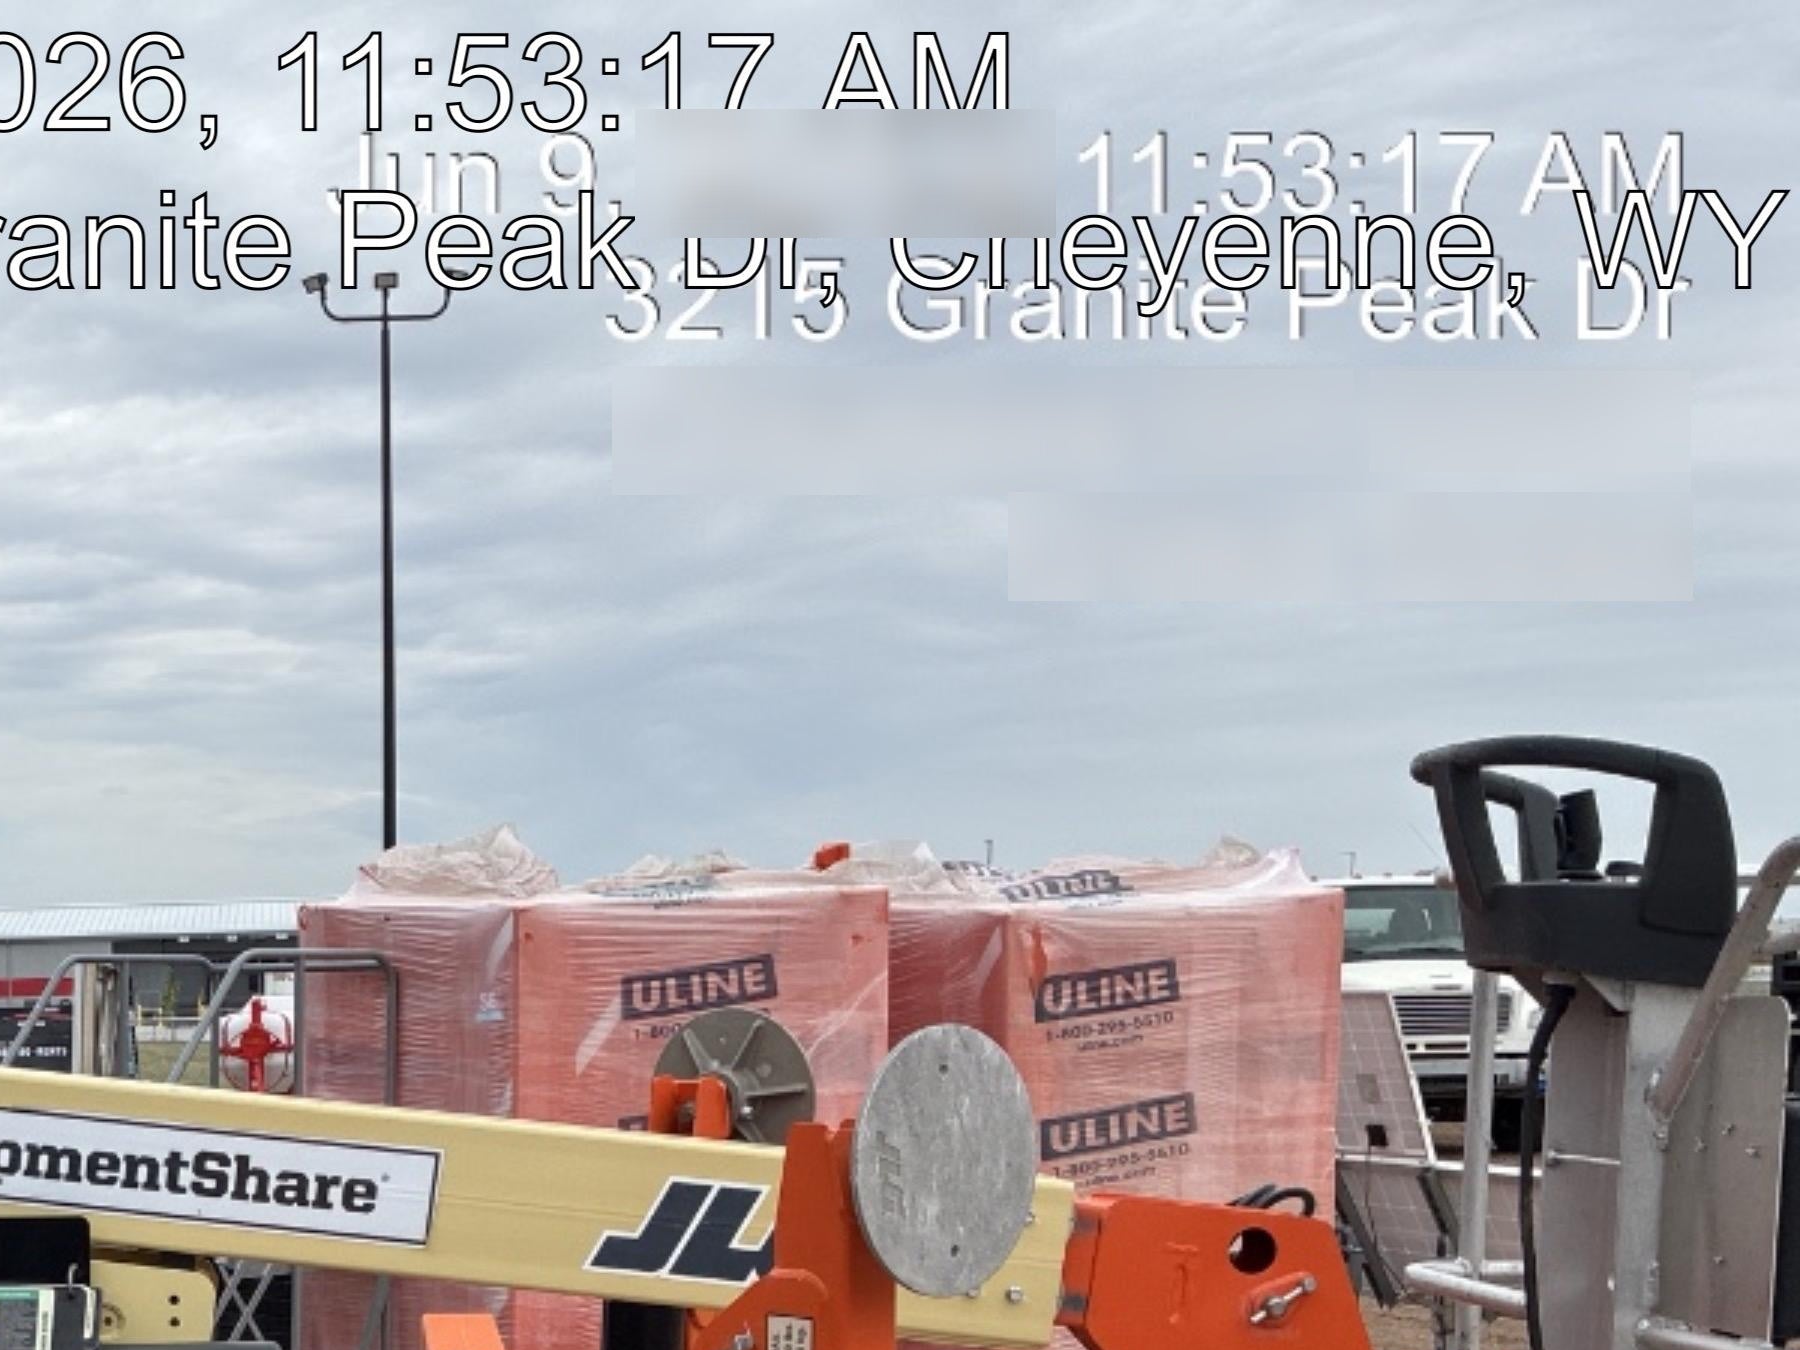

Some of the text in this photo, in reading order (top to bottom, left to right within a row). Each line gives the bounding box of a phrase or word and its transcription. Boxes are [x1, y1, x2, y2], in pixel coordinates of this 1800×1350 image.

[630, 961, 768, 1013] ULINE
[1042, 965, 1175, 1016] ULINE
[1050, 1099, 1191, 1153] ULINE
[582, 1175, 776, 1287] JL
